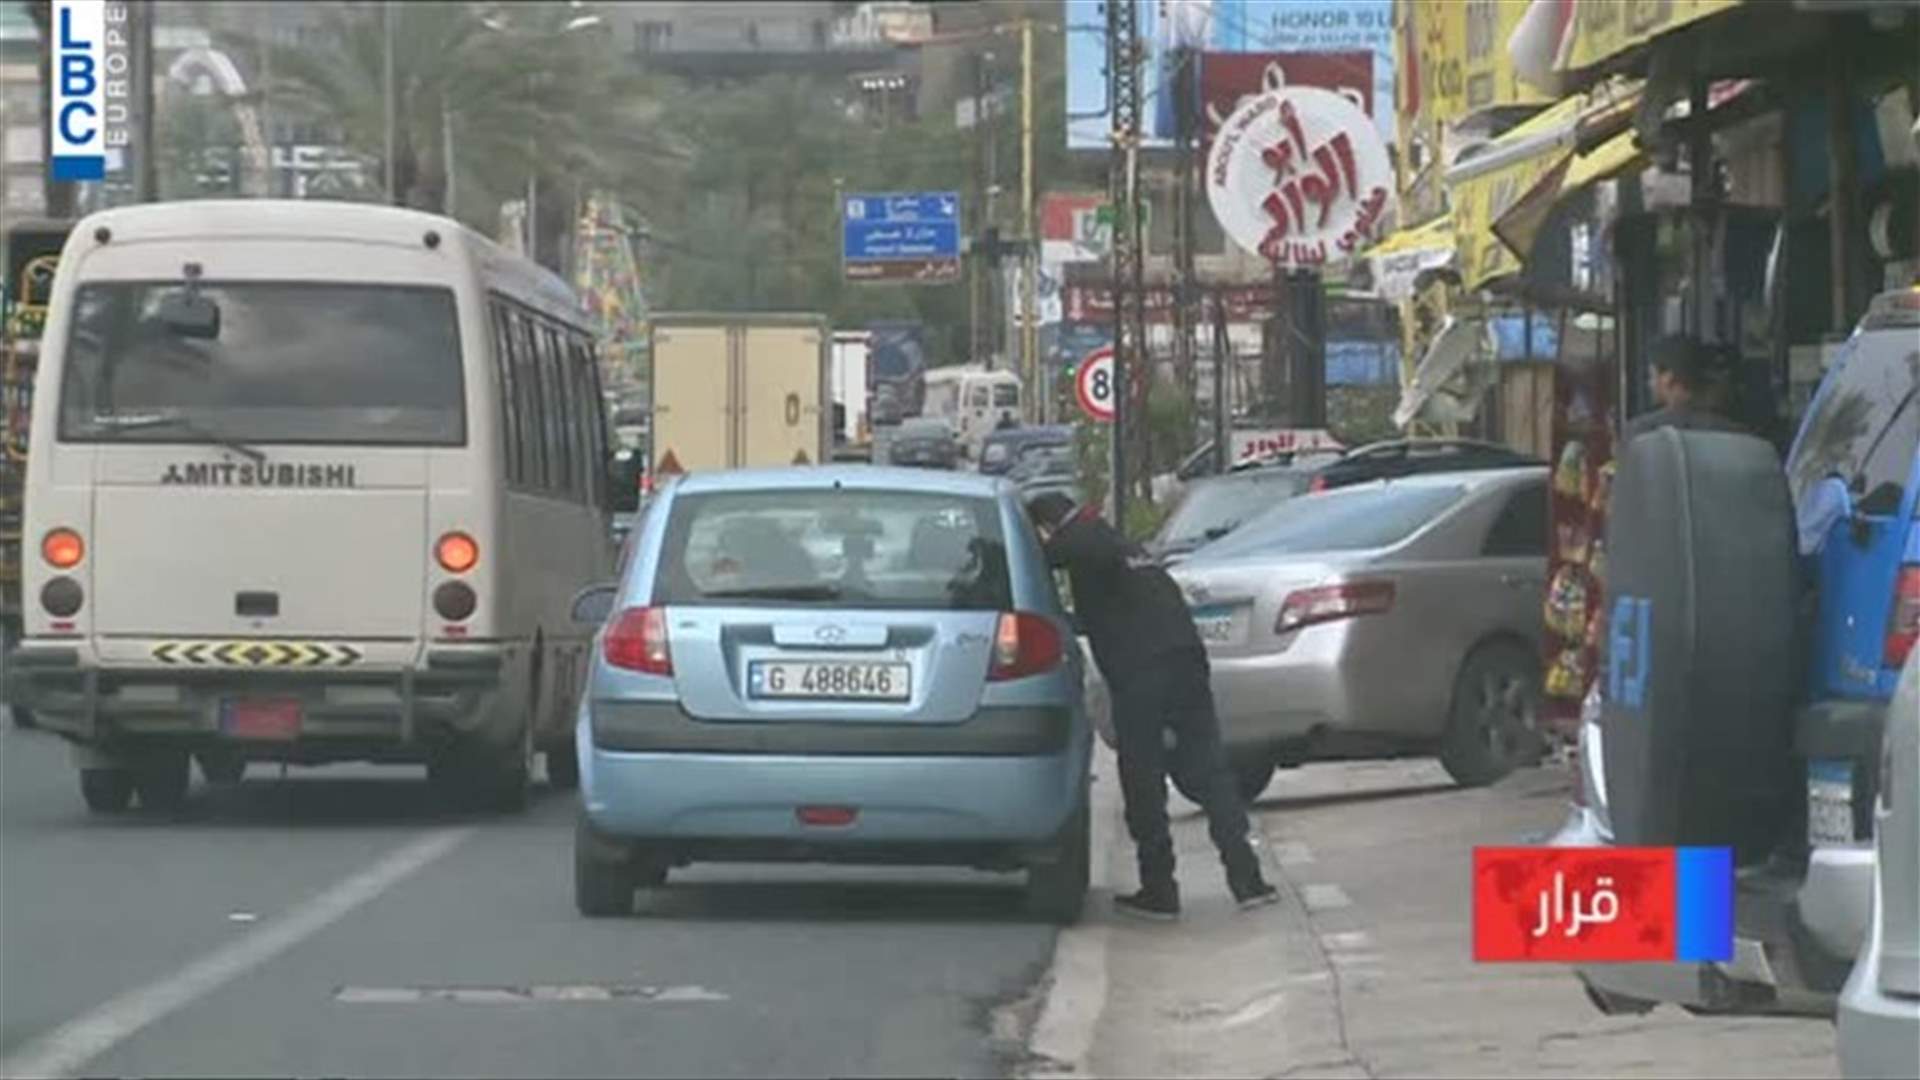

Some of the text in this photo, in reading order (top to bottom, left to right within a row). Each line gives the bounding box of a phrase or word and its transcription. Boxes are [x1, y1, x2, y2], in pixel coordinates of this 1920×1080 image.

[1271, 9, 1350, 29] HONOR
[1092, 368, 1110, 401] 8
[185, 462, 355, 488] MITSUBISHI
[769, 666, 893, 693] G 488646
